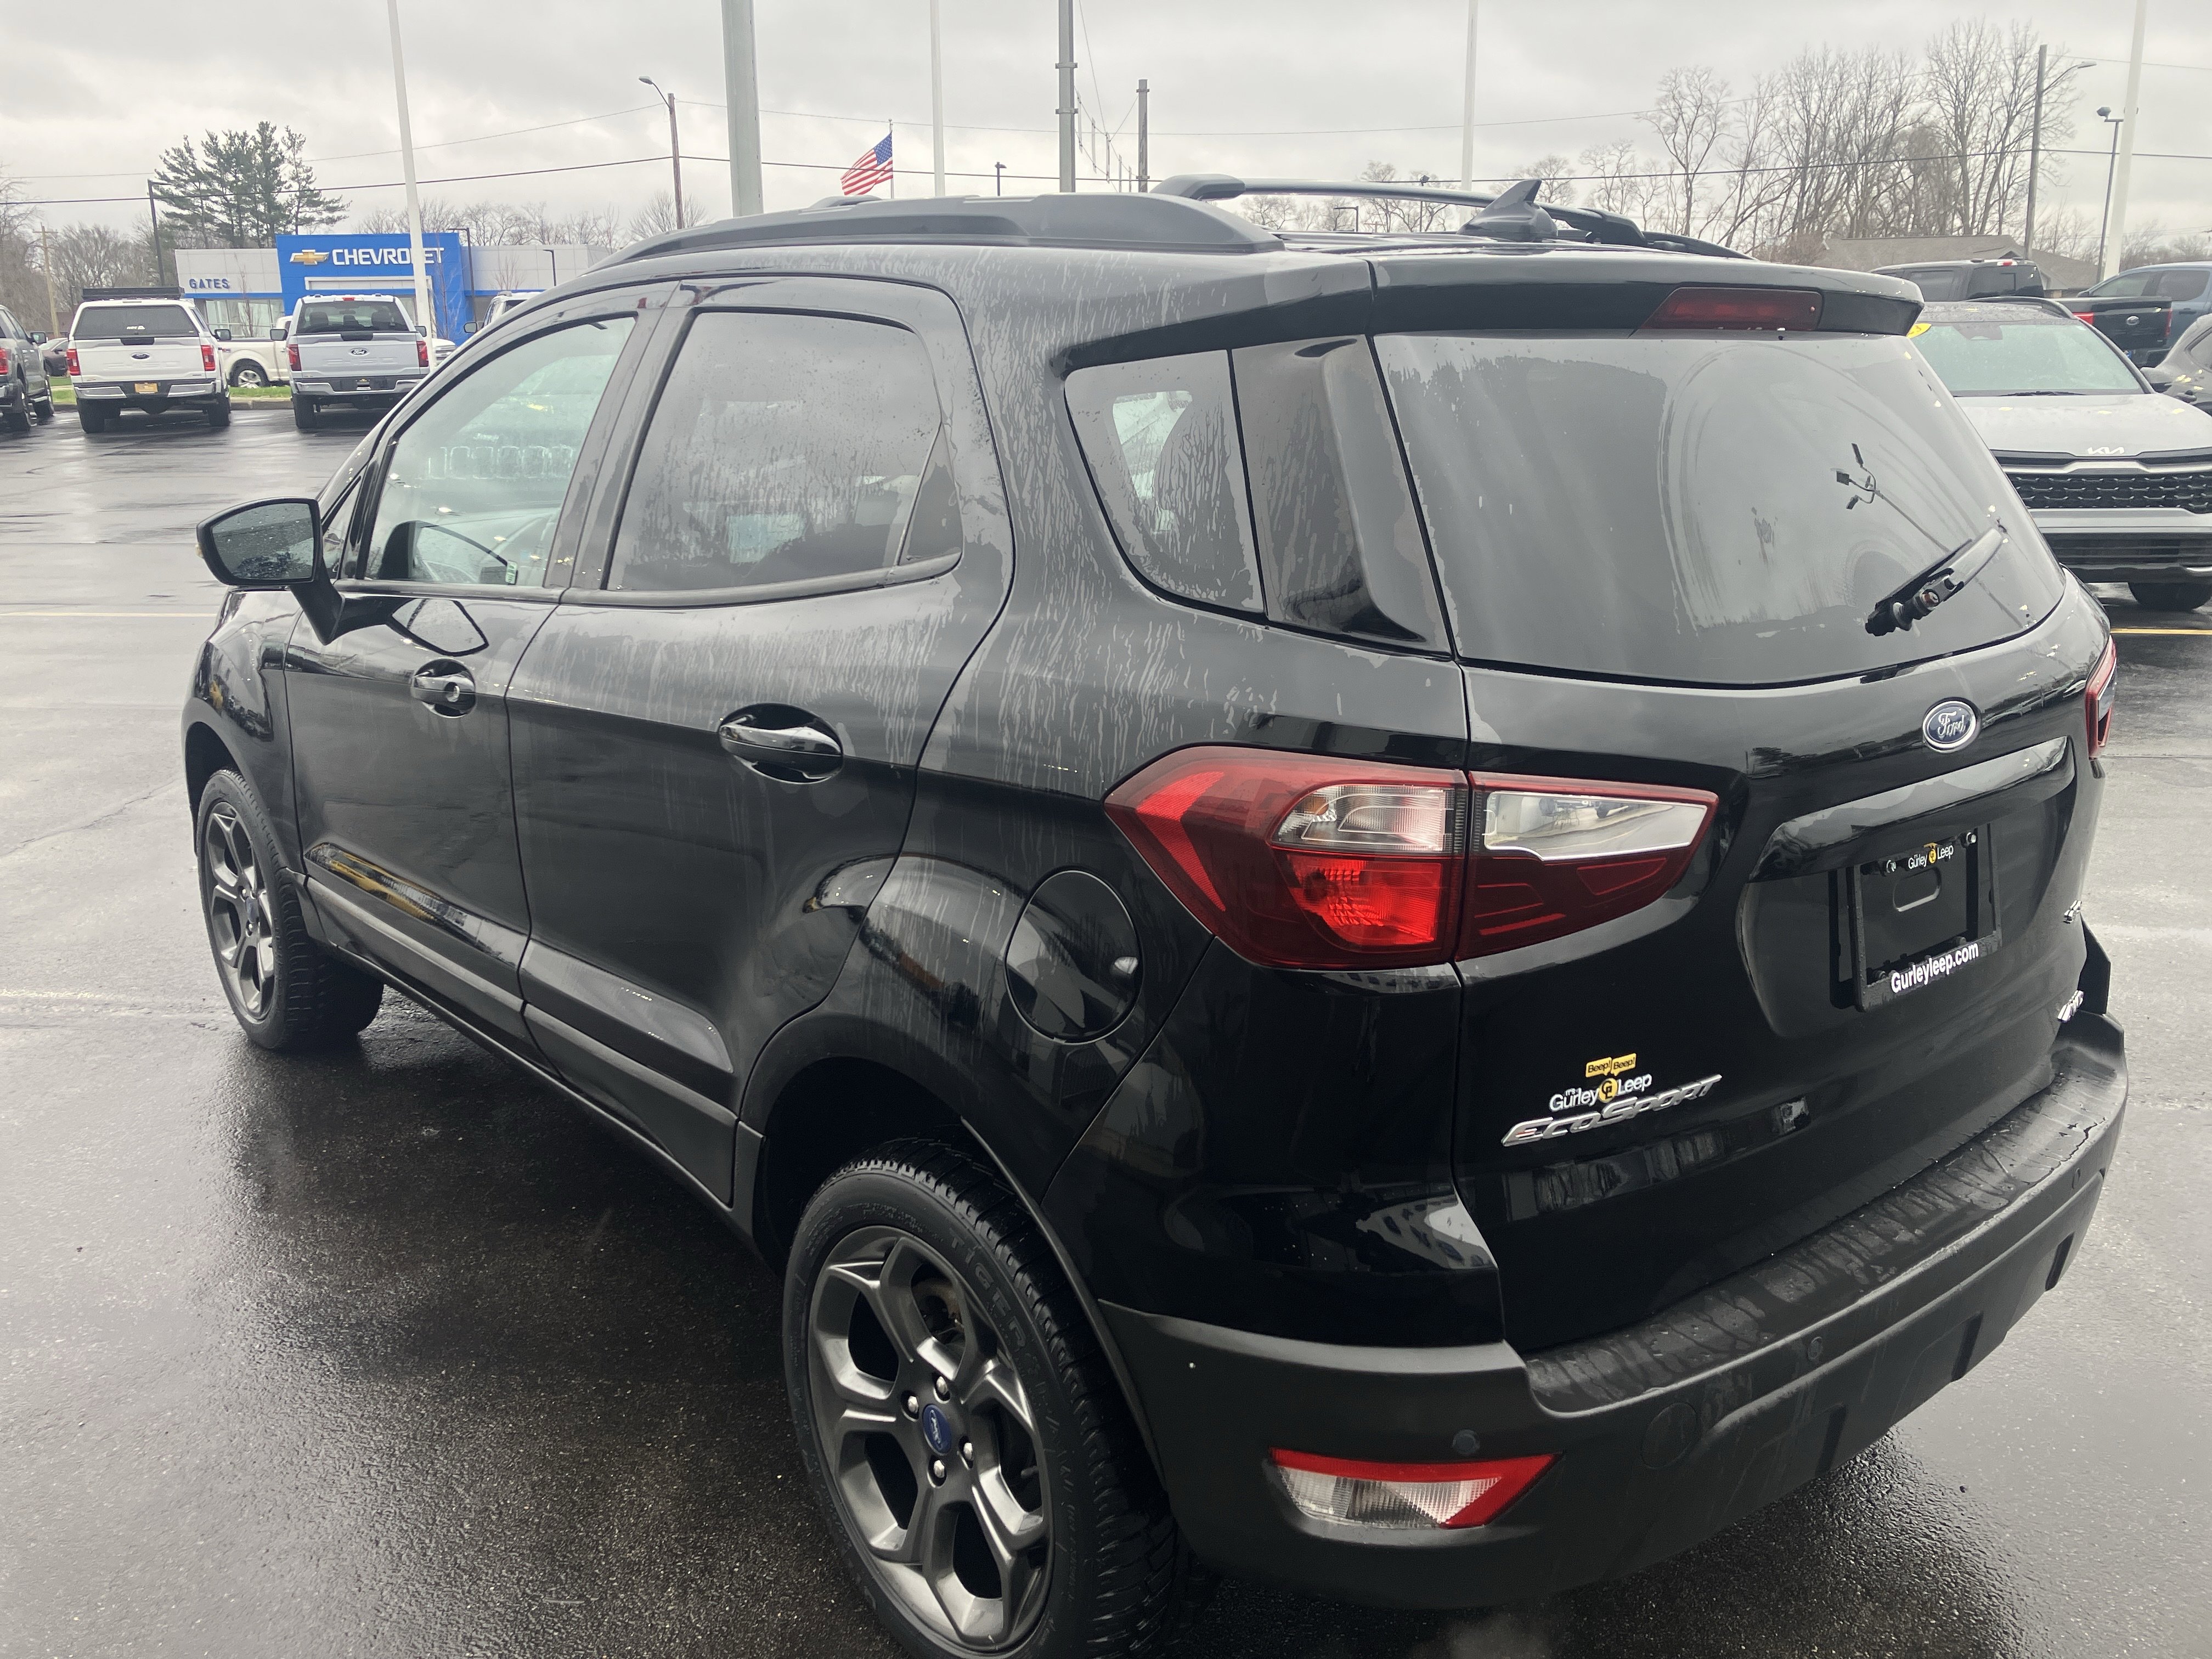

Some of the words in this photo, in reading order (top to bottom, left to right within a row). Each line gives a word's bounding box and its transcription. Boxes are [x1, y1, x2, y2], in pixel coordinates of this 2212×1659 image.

[331, 247, 445, 266] CHEVROET
[189, 279, 230, 289] GATES
[1937, 711, 1967, 739] Ford
[1908, 854, 1927, 870] Gurley
[1937, 845, 1954, 860] Leep
[1891, 943, 1979, 993] Gurleyleep.com
[1587, 1060, 1611, 1073] Beep!
[1613, 1057, 1636, 1070] Beep!
[1549, 1087, 1600, 1111] Gurley
[1617, 1074, 1652, 1096] Leep
